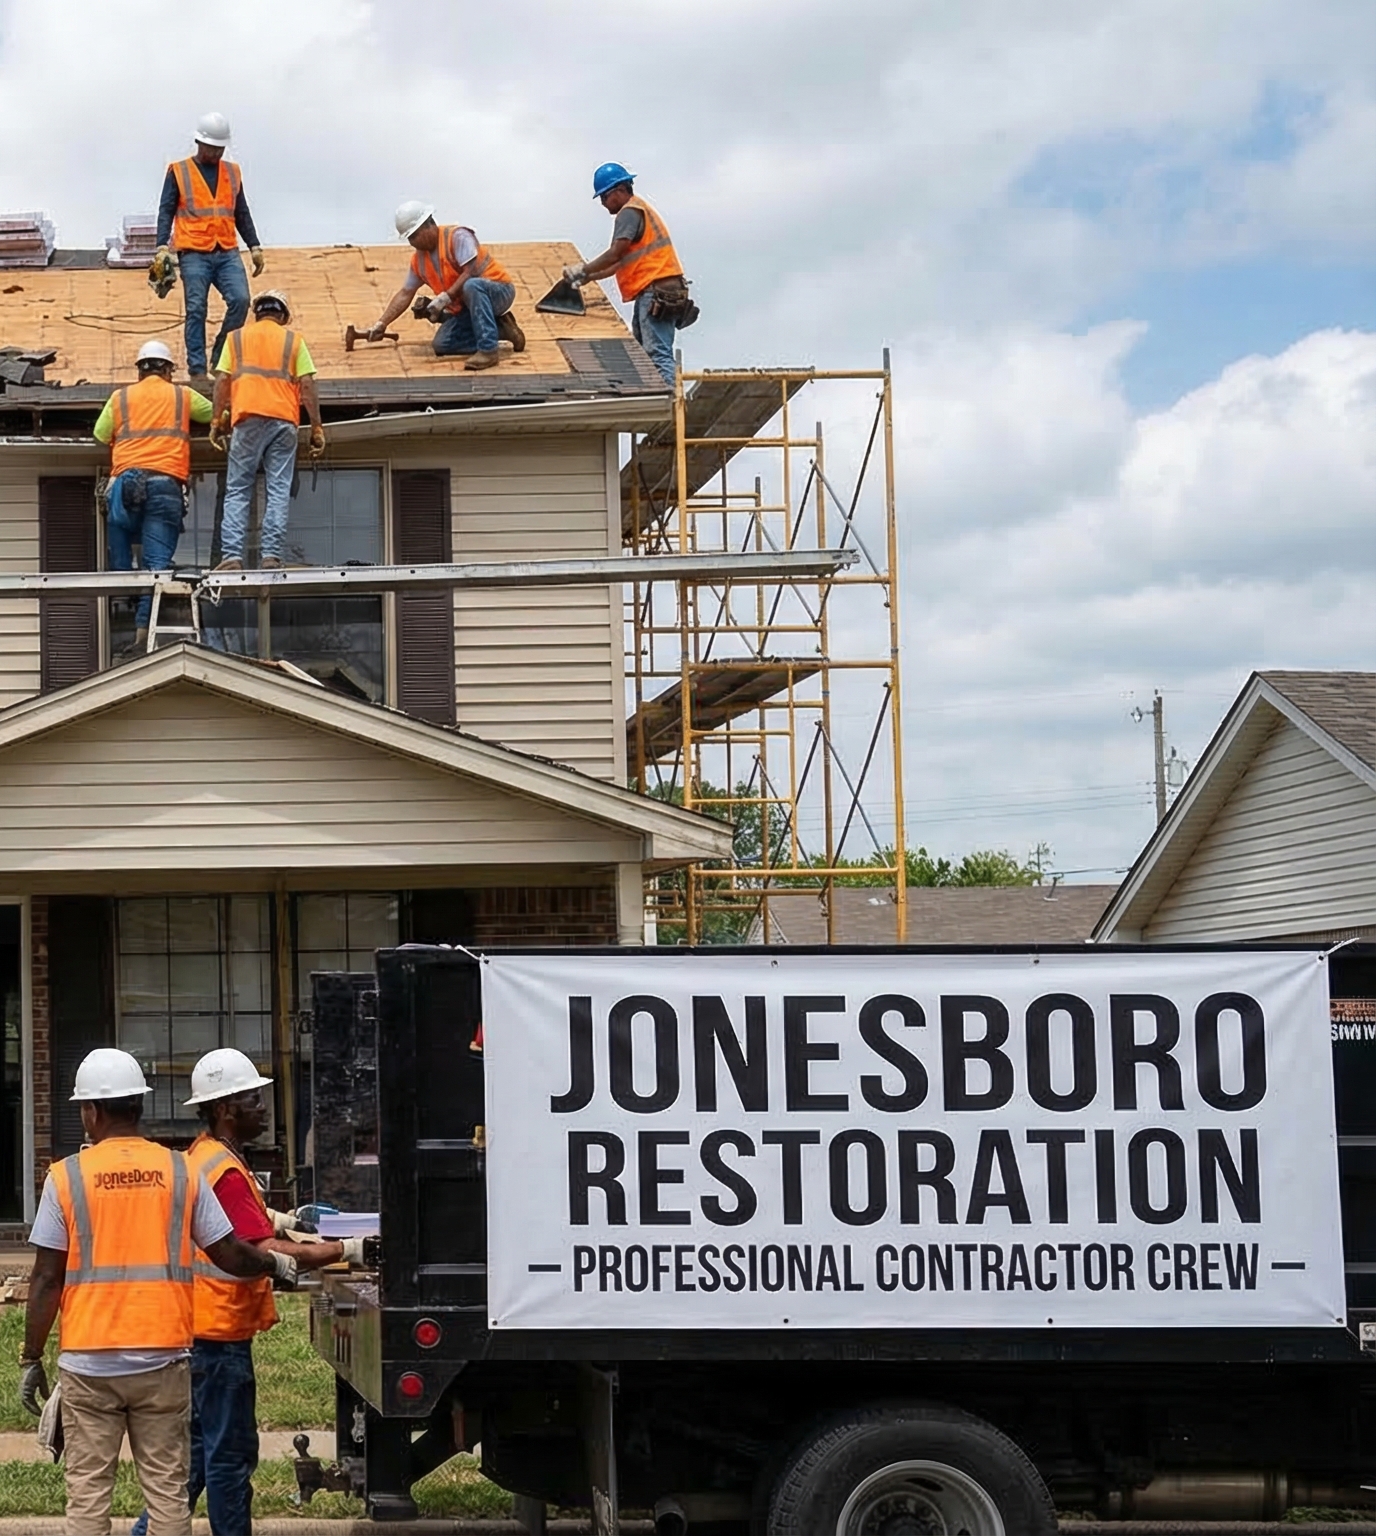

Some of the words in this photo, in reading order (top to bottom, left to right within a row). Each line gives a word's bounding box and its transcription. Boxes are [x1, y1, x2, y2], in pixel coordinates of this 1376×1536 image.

[548, 992, 1267, 1114] JONESBORO
[567, 1128, 1261, 1227] RESTORATION
[573, 1244, 865, 1293] PROFESSIONAL
[875, 1243, 1136, 1292] CONTRACTOR
[1147, 1242, 1259, 1291] CREW
